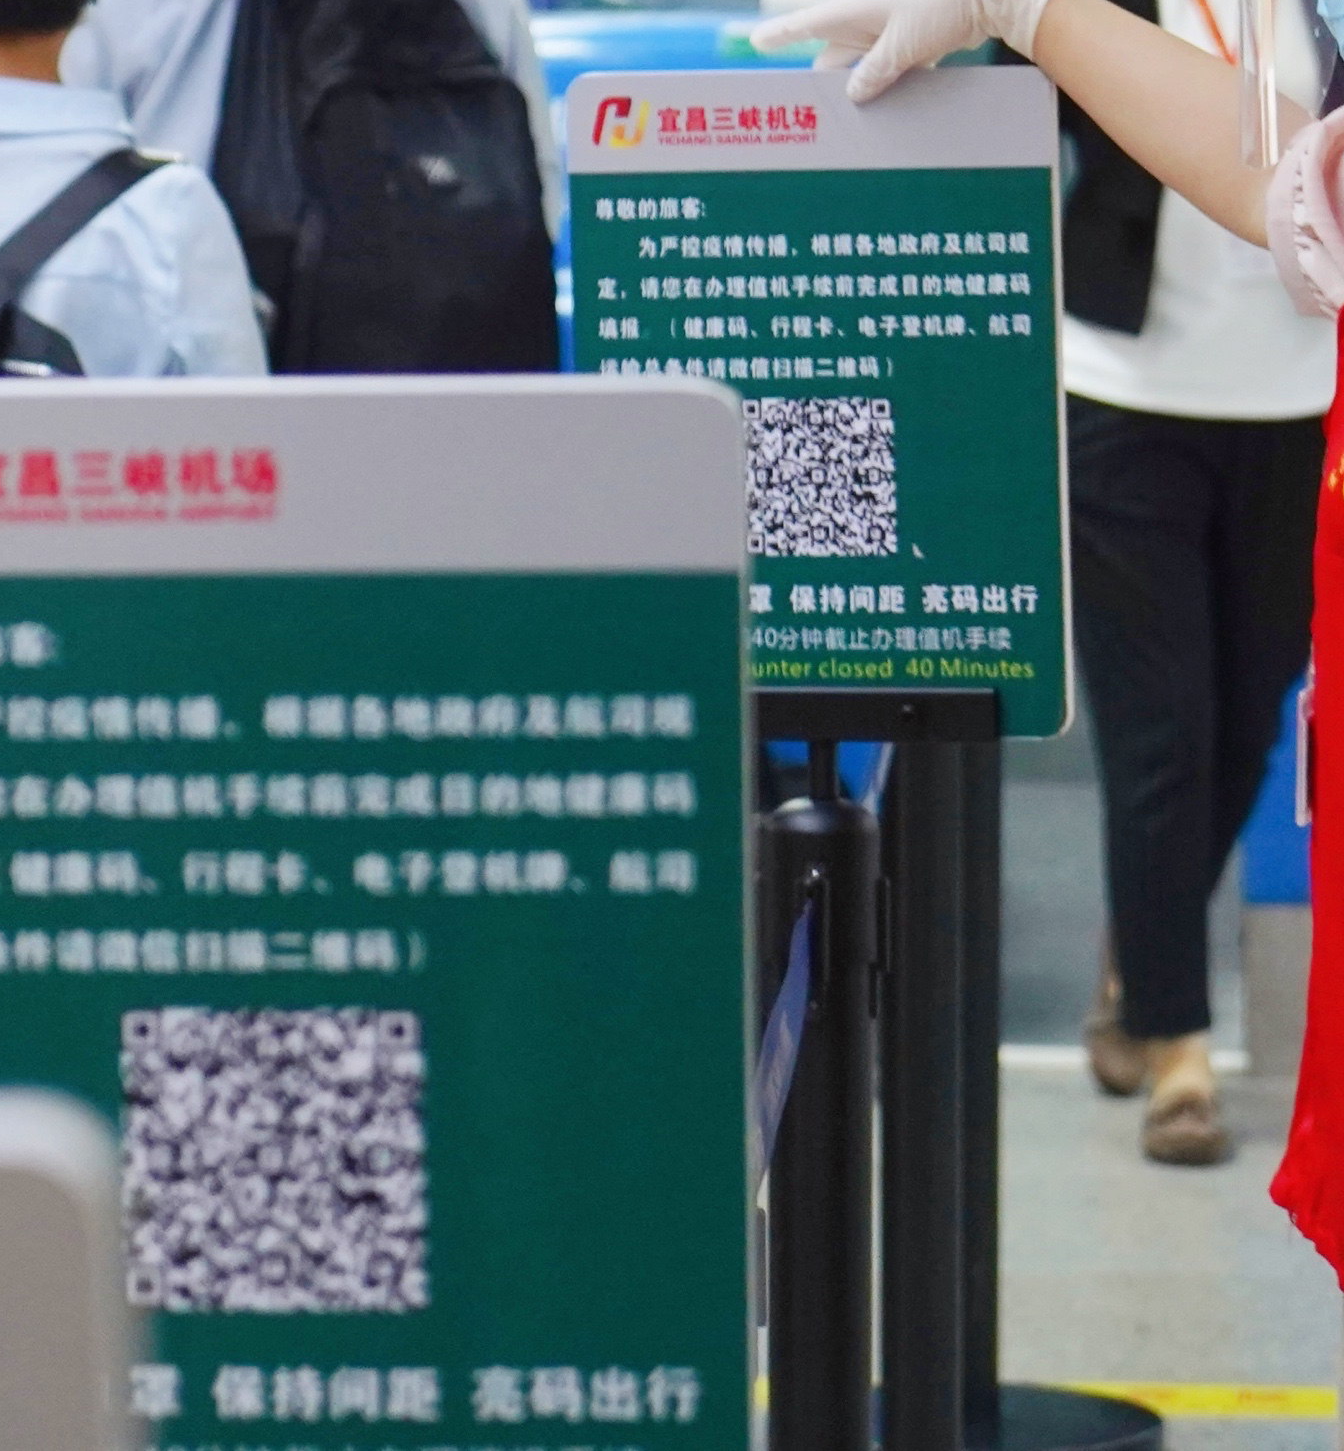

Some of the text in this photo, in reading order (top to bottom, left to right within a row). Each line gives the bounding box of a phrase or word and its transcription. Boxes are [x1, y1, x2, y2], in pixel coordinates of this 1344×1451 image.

[657, 105, 818, 133] 宜昌三峡机场
[789, 583, 905, 614] 保持间距
[921, 583, 1039, 614] 亮码出行
[750, 656, 1036, 680] unter closed 40 Minutes
[213, 1362, 441, 1423] 保持间距
[471, 1363, 702, 1425] 亮码出行
